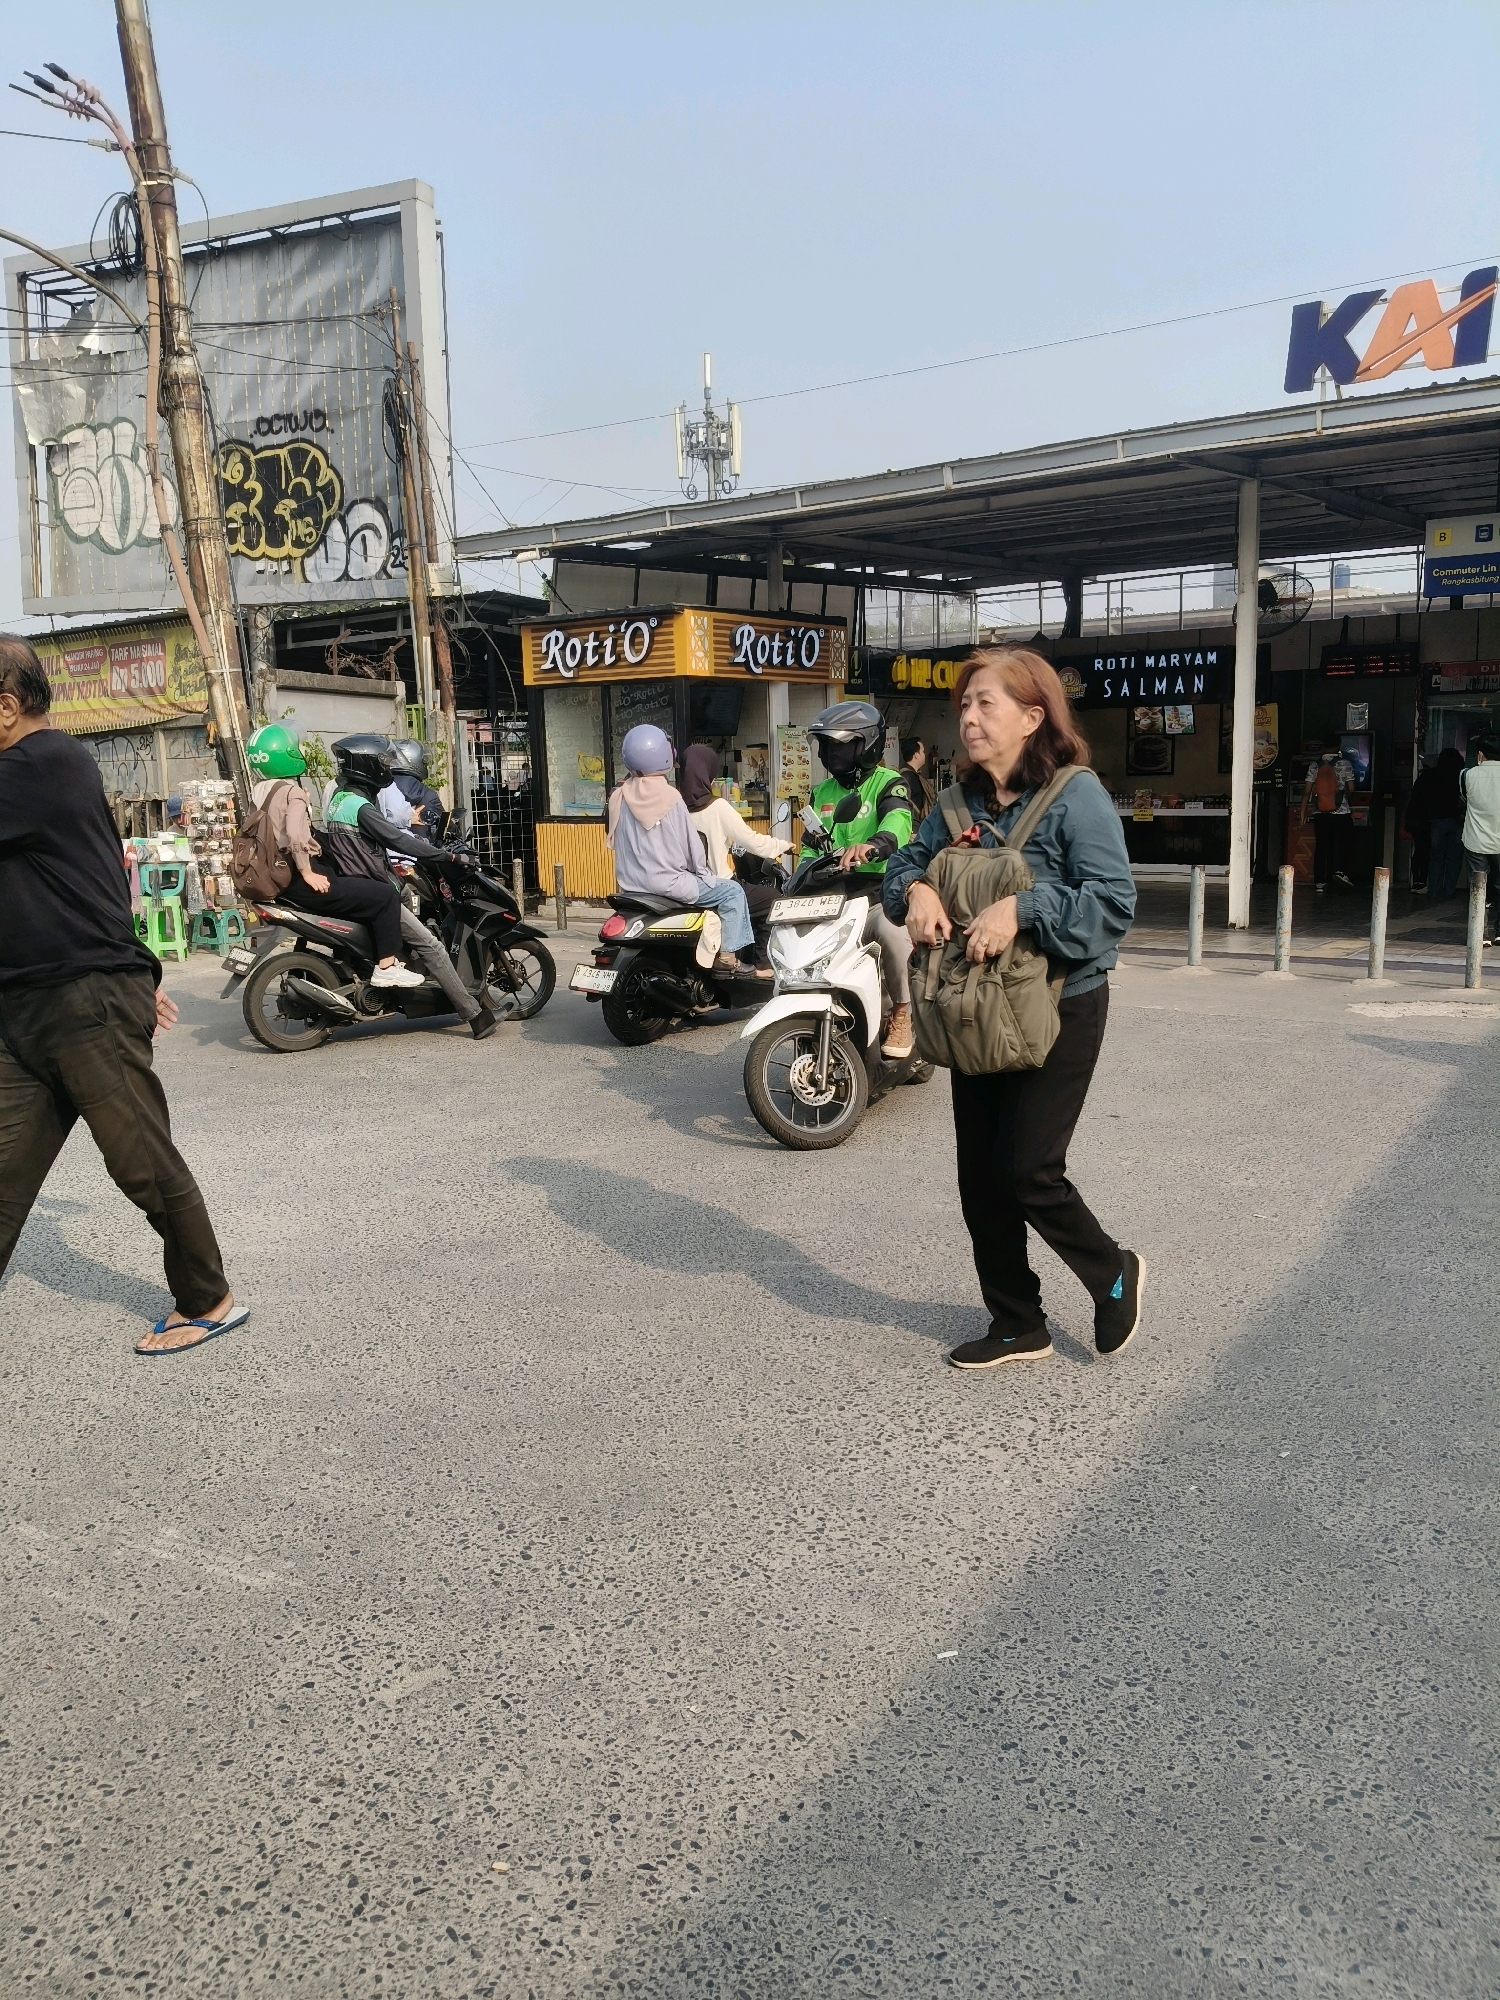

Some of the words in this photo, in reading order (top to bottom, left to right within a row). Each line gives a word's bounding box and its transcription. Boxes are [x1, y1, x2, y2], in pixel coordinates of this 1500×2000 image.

[1284, 266, 1499, 394] KAI
[1439, 532, 1447, 541] B
[1432, 566, 1480, 577] Commuter
[1441, 576, 1500, 586] Rangkasbitung
[111, 646, 129, 662] TARIF
[1094, 656, 1135, 670] ROTI
[1145, 651, 1217, 667] MARYAM
[131, 660, 164, 688] 5.000
[1103, 674, 1204, 698] SALMAN
[774, 902, 782, 910] B
